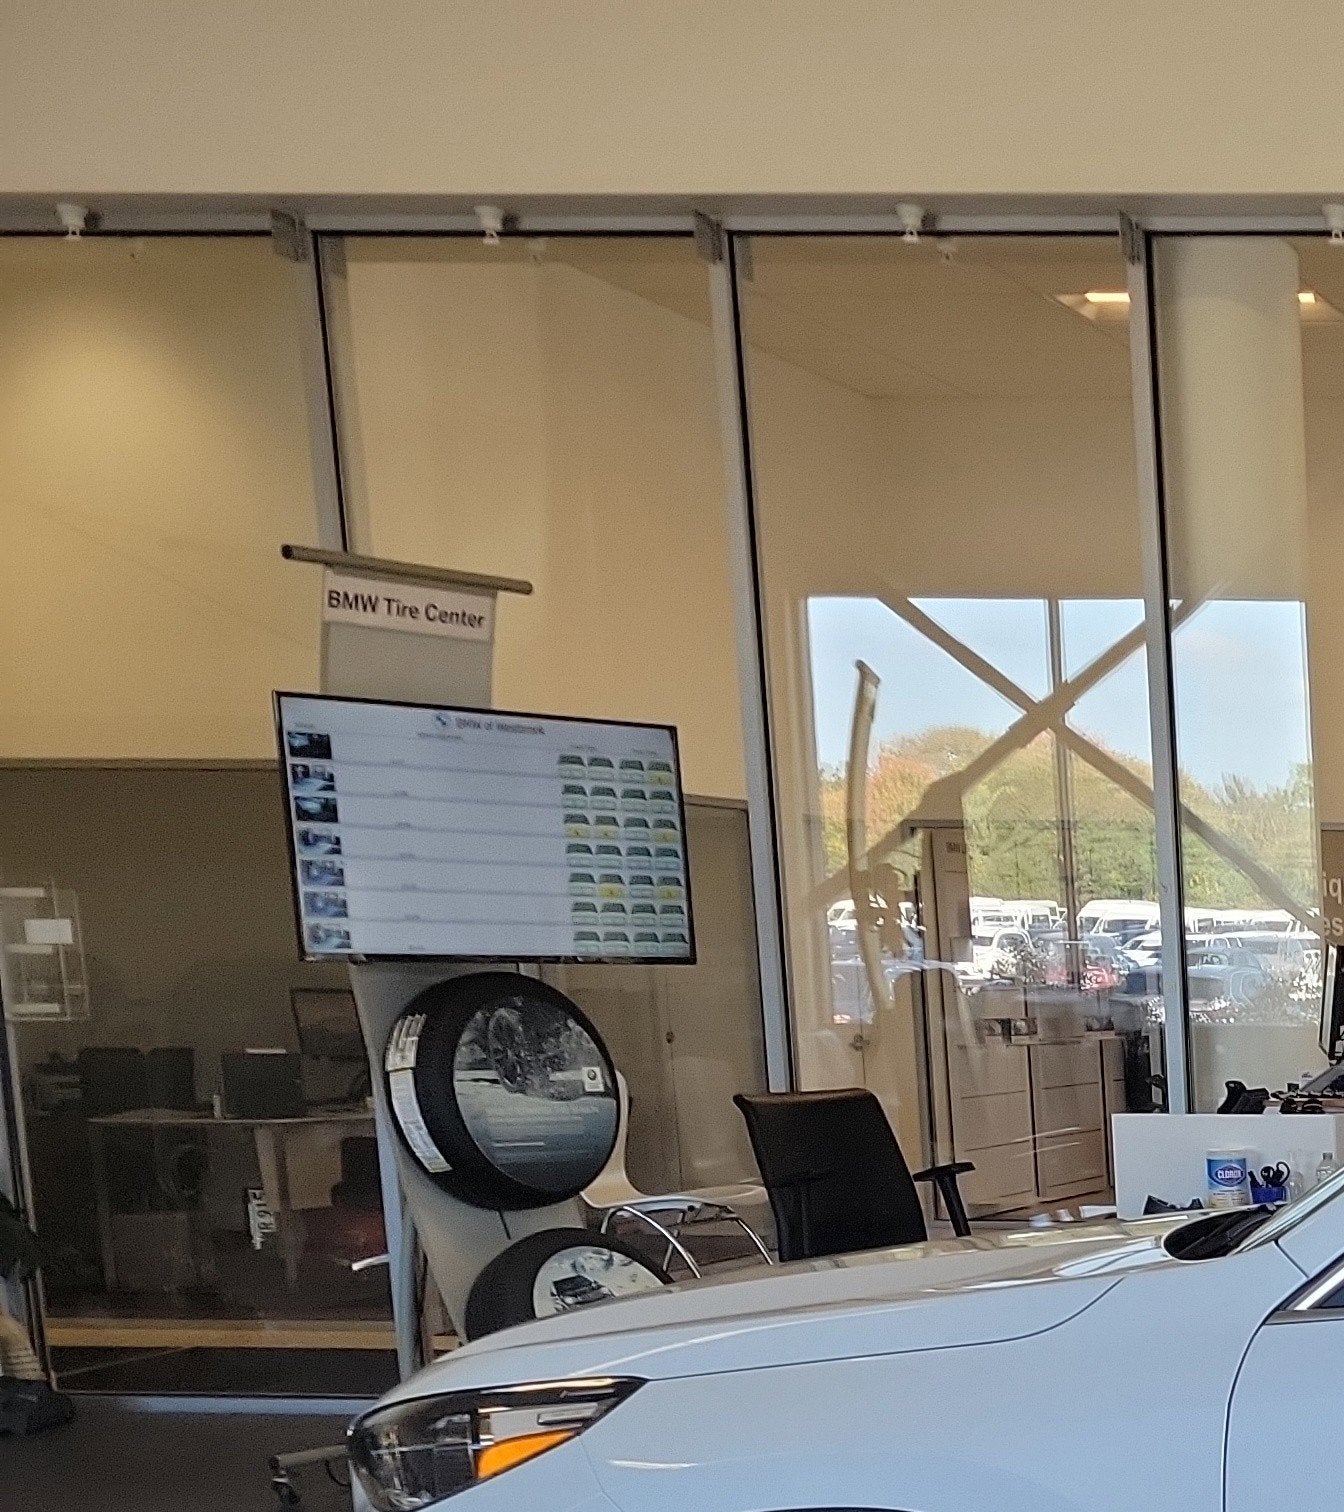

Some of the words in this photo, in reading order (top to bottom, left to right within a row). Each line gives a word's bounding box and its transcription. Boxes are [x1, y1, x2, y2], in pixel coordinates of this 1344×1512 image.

[327, 589, 379, 613] BMW
[383, 597, 420, 619] Tire
[424, 602, 485, 629] Center
